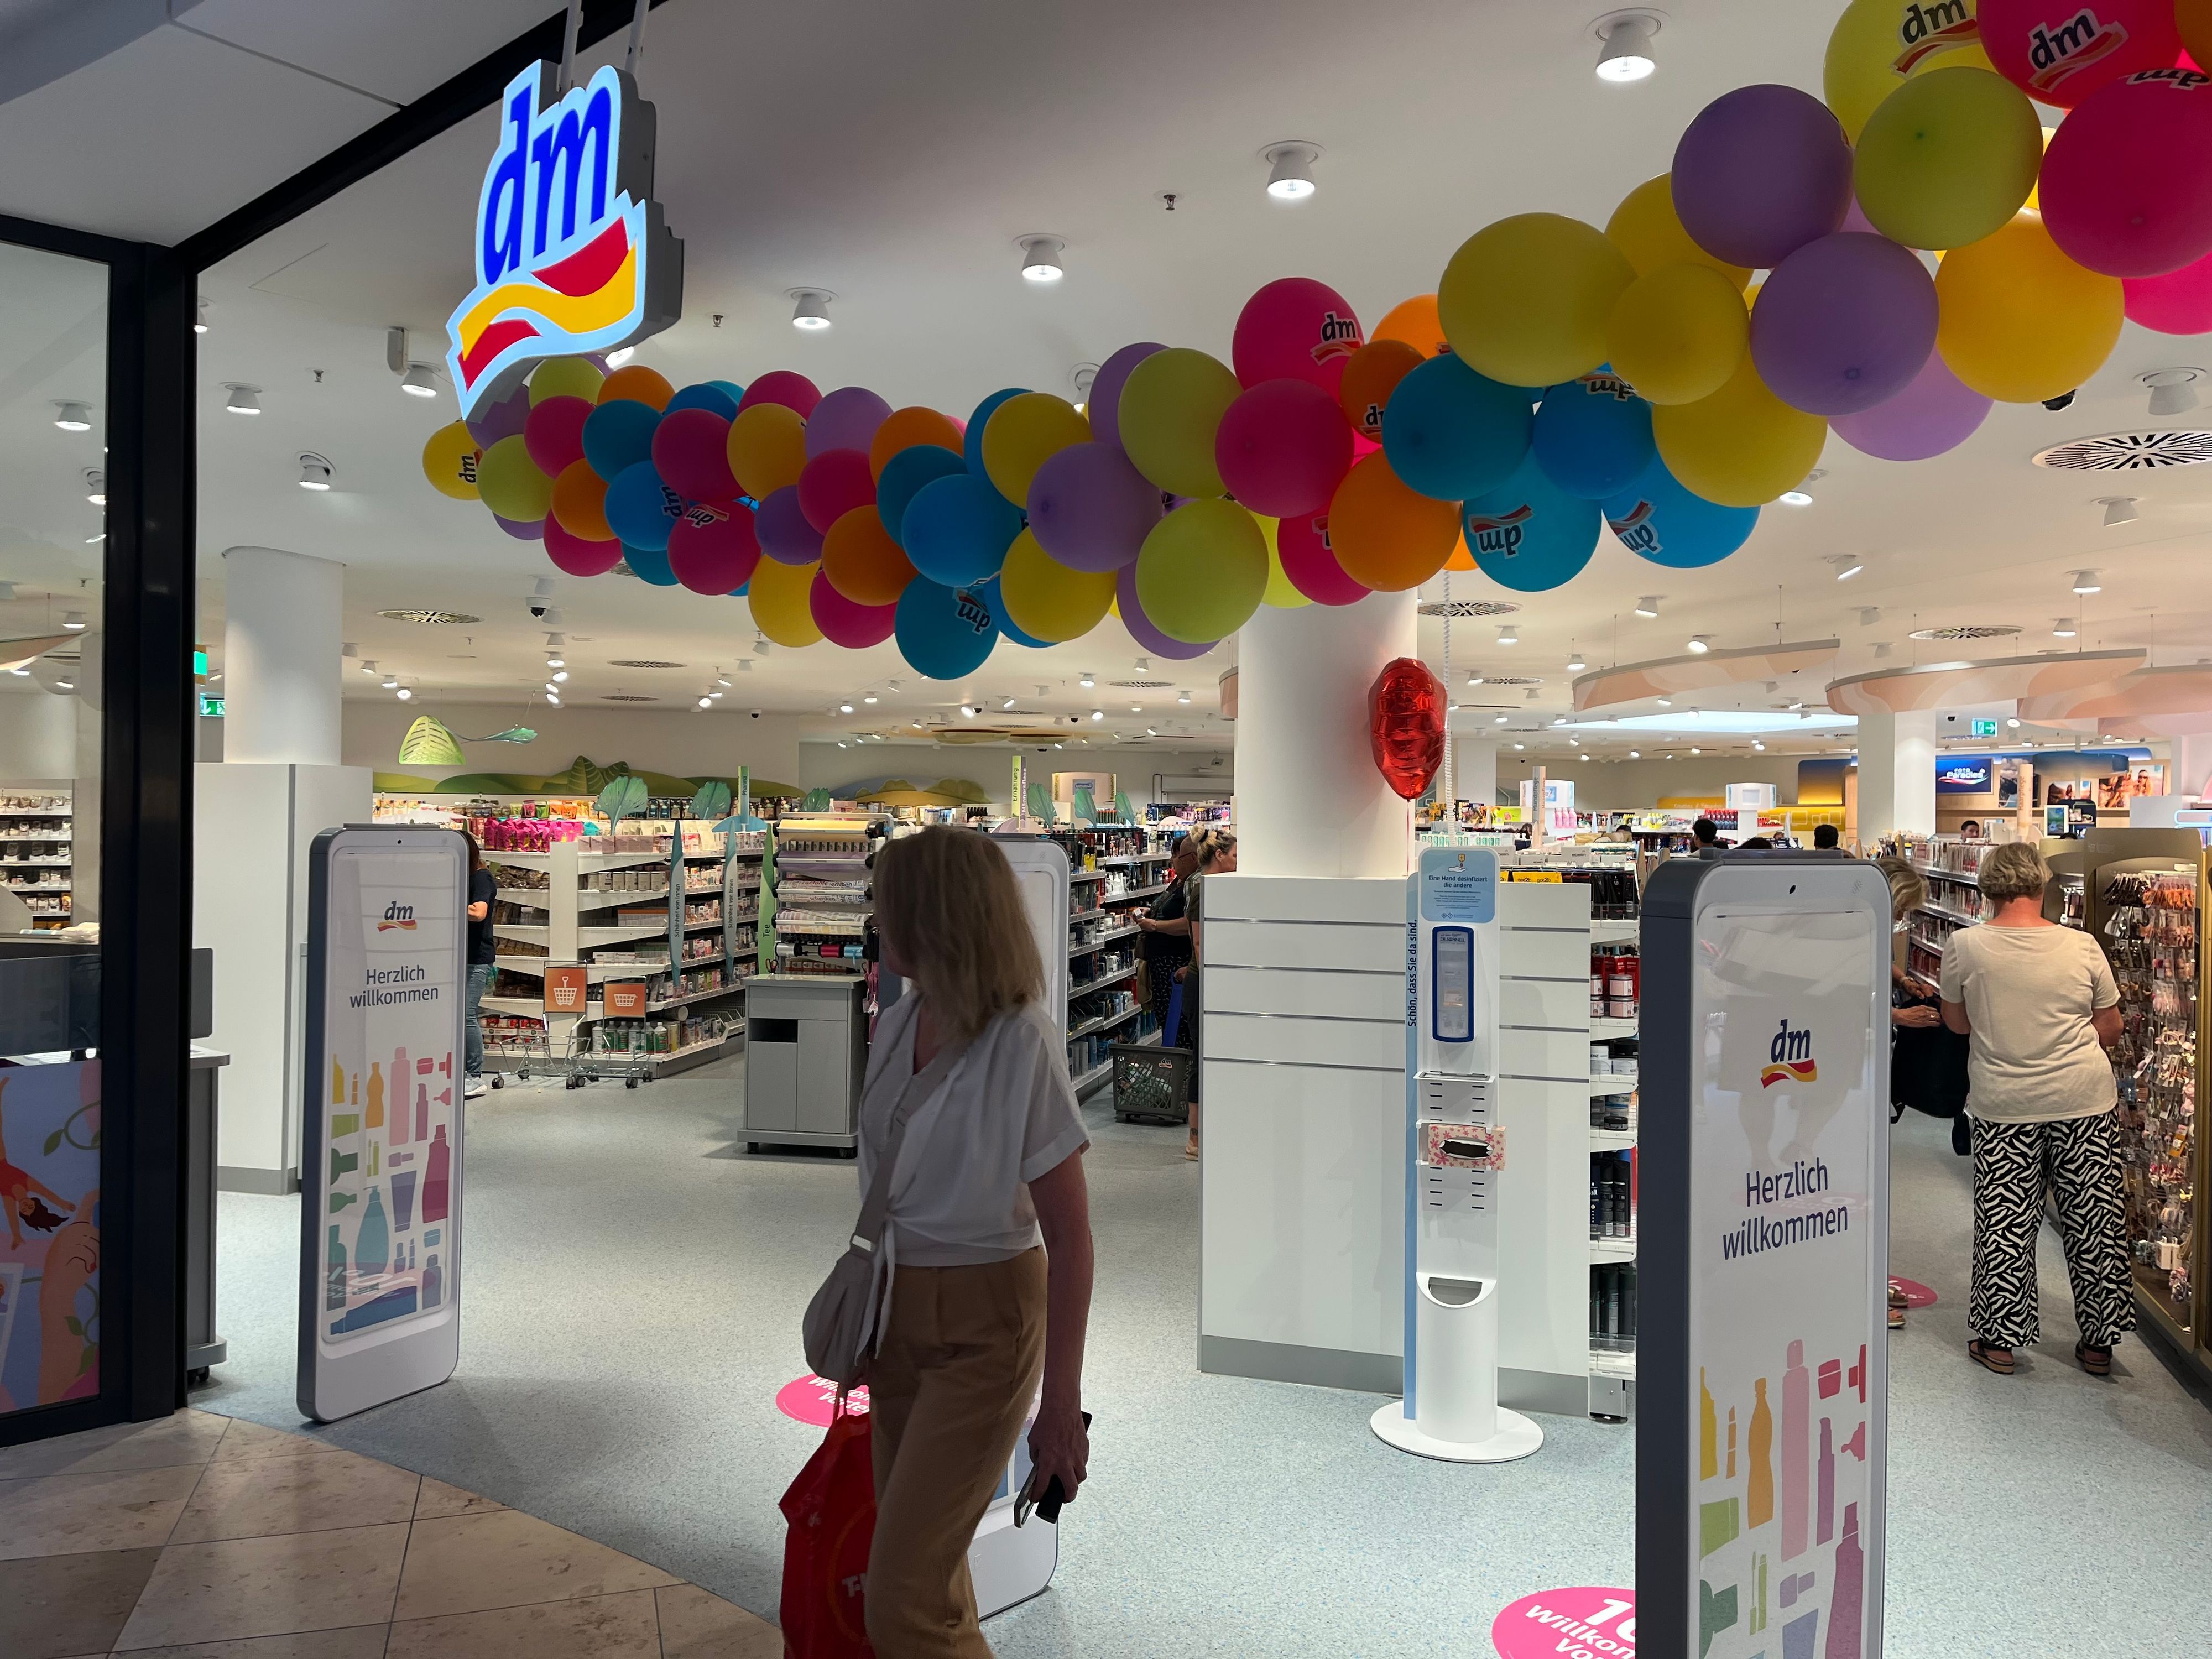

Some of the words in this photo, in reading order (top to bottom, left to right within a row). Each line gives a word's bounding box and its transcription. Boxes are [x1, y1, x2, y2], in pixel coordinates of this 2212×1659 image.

[1902, 0, 1966, 44] dm
[2031, 15, 2096, 69] dm
[484, 83, 612, 285] dm
[1322, 314, 1356, 342] dm
[458, 456, 477, 483] dm
[687, 509, 714, 526] dm
[1479, 525, 1522, 556] dm
[957, 603, 991, 633] dm
[384, 901, 413, 920] dm
[1408, 920, 1417, 940] sind.
[1408, 944, 1416, 954] da
[367, 965, 425, 985] Herzlich
[1408, 957, 1416, 971] Sie
[350, 987, 438, 1008] willkommen
[1408, 974, 1416, 993] dass
[1408, 997, 1417, 1026] Schön,
[1771, 1019, 1810, 1063] dm
[1746, 1157, 1828, 1207] Herzlich
[1723, 1206, 1848, 1260] willkommen
